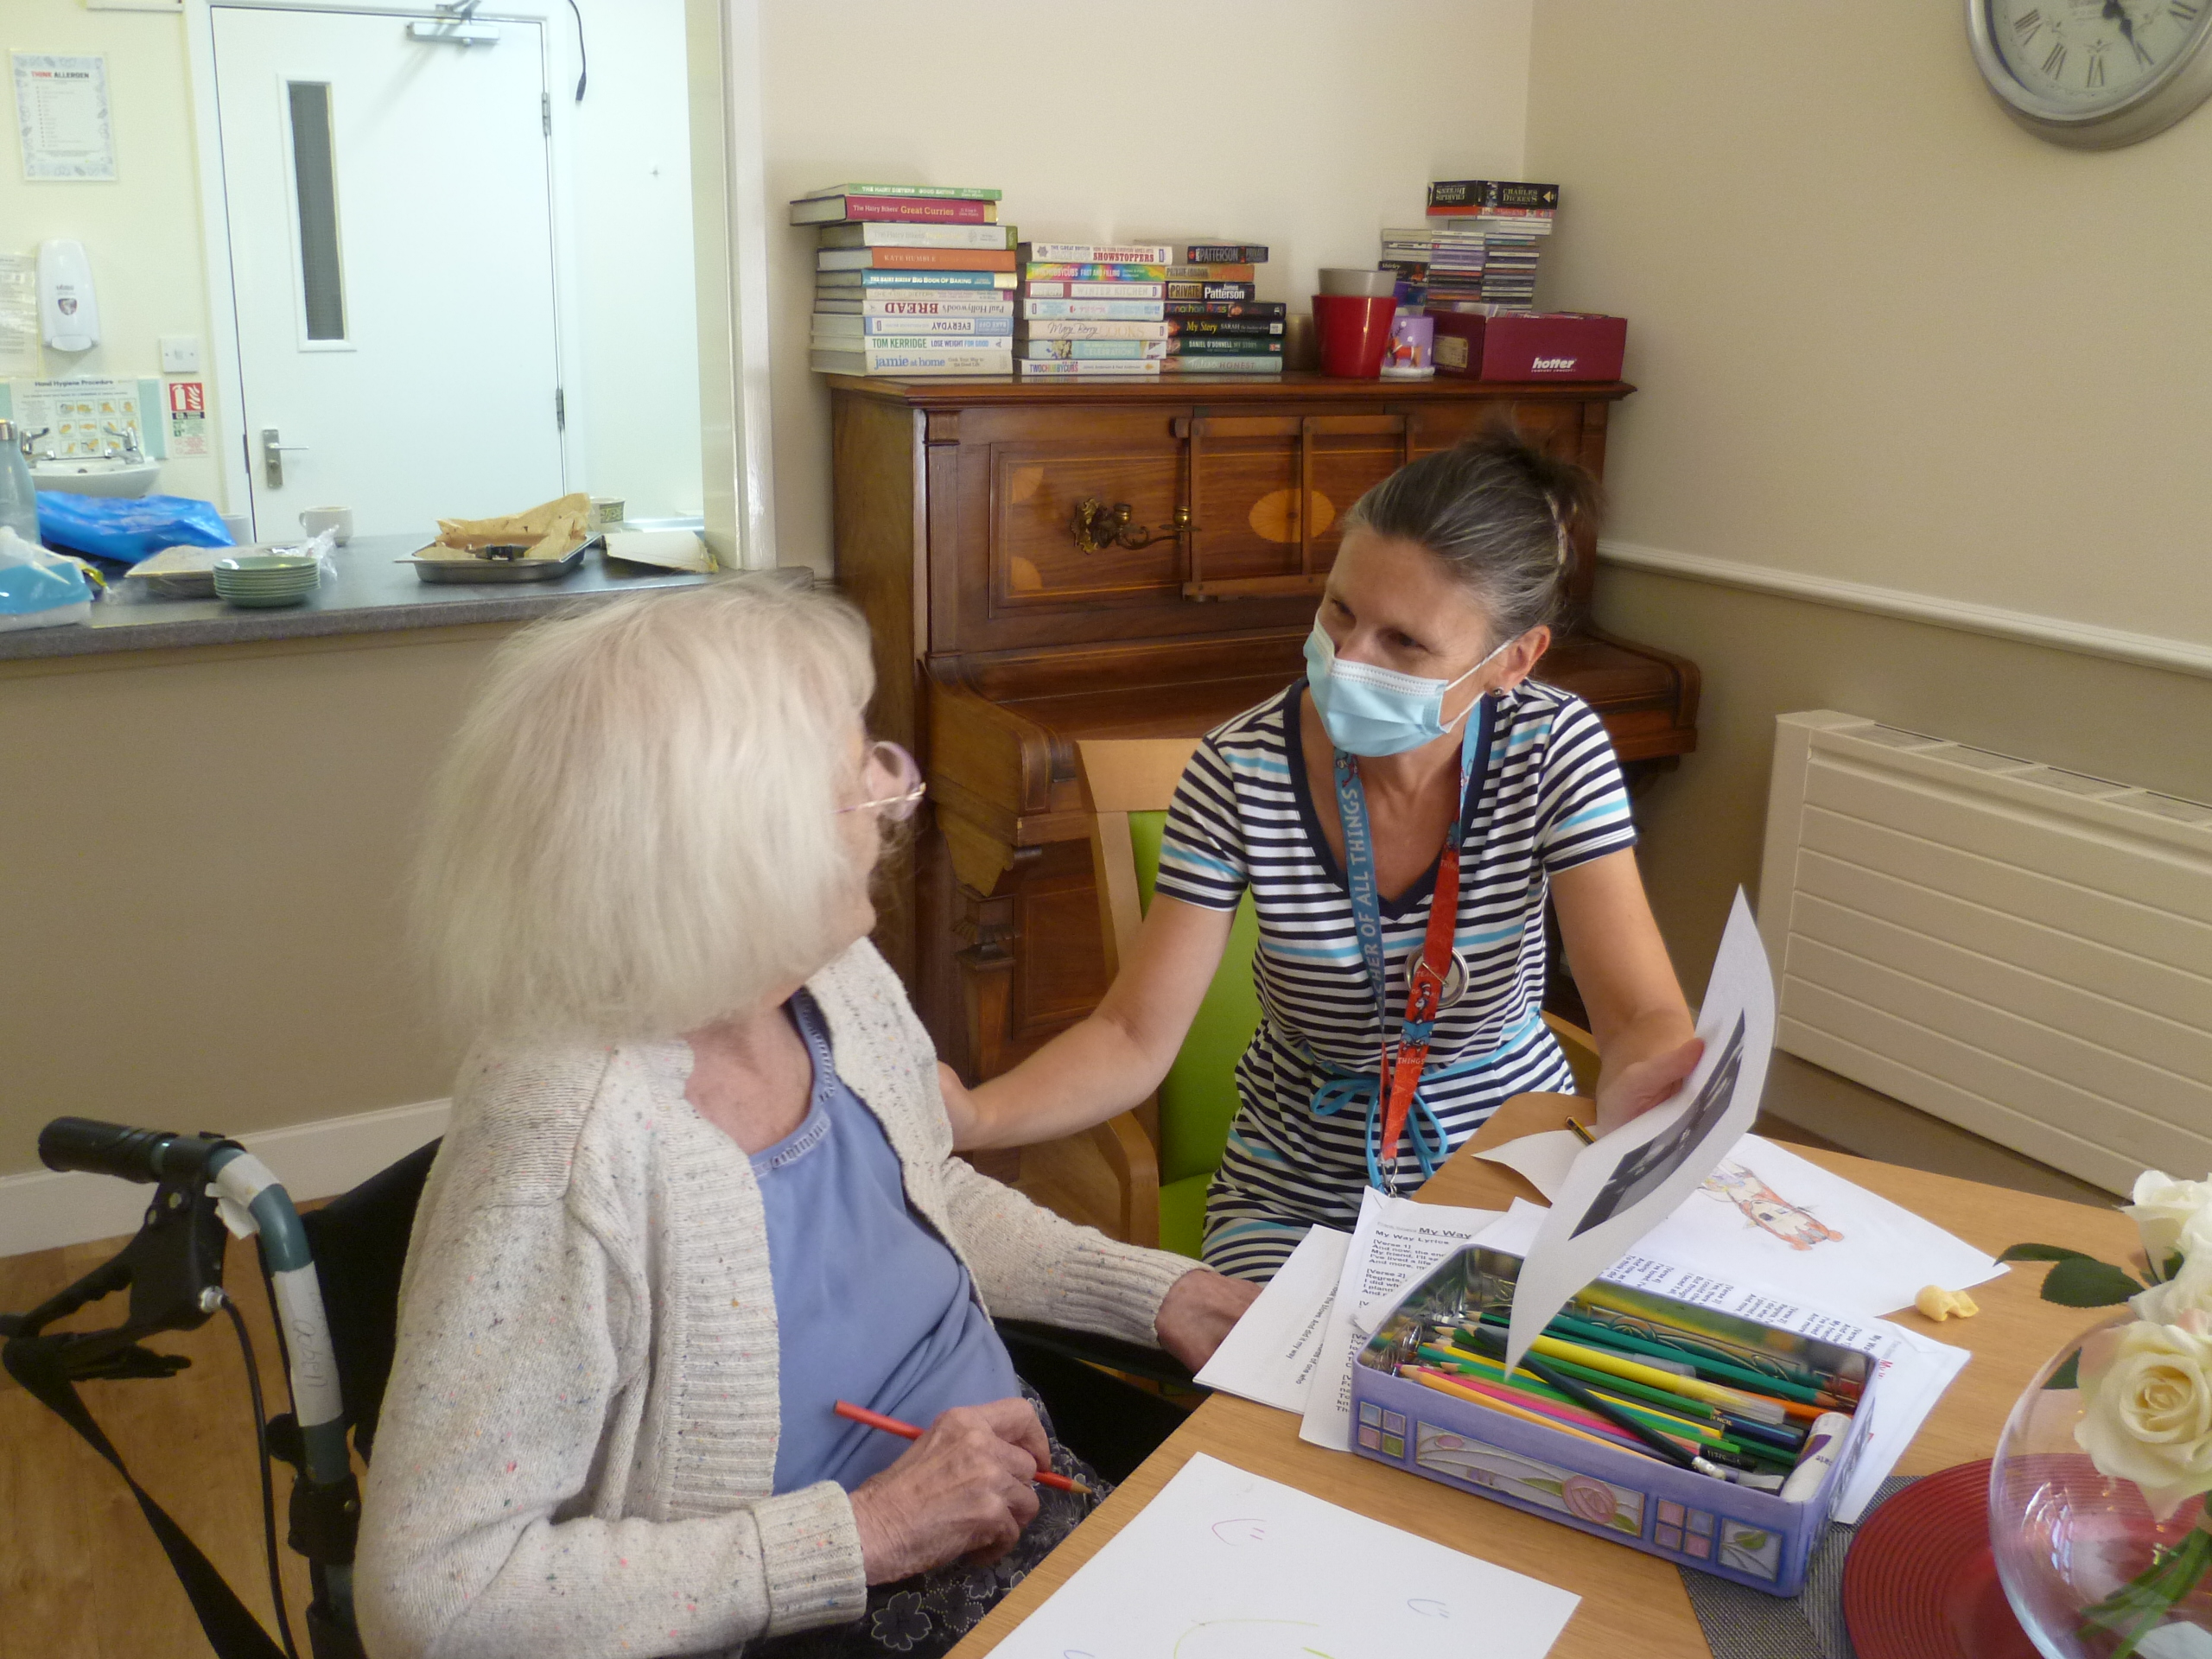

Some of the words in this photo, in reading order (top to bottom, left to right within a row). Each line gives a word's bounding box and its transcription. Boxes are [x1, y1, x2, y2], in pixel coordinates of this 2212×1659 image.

[865, 205, 880, 213] Hairy
[900, 206, 923, 214] Great
[925, 207, 954, 216] Curries
[1092, 252, 1154, 263] SHOWSTOPPERS
[1200, 248, 1238, 261] PATTERSON
[1077, 286, 1112, 296] WINTER
[1114, 286, 1148, 296] KITCHEN
[1170, 285, 1200, 298] PRIVATE
[1205, 287, 1245, 300] Patterson
[885, 302, 938, 314] BREAD
[943, 303, 987, 315] Hollywood's
[988, 303, 1004, 313] Paul
[931, 321, 971, 331] EVERYDAY
[1048, 322, 1074, 338] Mary
[1074, 322, 1098, 339] Berry
[1185, 321, 1198, 332] My
[1201, 321, 1217, 334] Story
[873, 338, 888, 349] TOM
[890, 338, 927, 349] KERRIDGE
[874, 355, 909, 370] jamie
[918, 357, 945, 367] home
[1219, 361, 1255, 370] HONEST
[1532, 357, 1574, 369] hotter
[1342, 788, 1367, 866] THINGS
[1353, 871, 1373, 907] ALL
[1358, 912, 1376, 938] OF
[1397, 1056, 1425, 1065] THINGS
[1393, 1232, 1414, 1242] Way
[1419, 1227, 1439, 1236] My
[1442, 1229, 1471, 1239] Way
[1373, 1239, 1402, 1248] [Verse
[1366, 1268, 1395, 1277] [Verse
[1307, 1319, 1319, 1330] And
[1302, 1329, 1313, 1338] did
[1293, 1341, 1303, 1351] my
[1286, 1349, 1297, 1360] way
[1303, 1363, 1313, 1374] one
[1295, 1374, 1306, 1384] who
